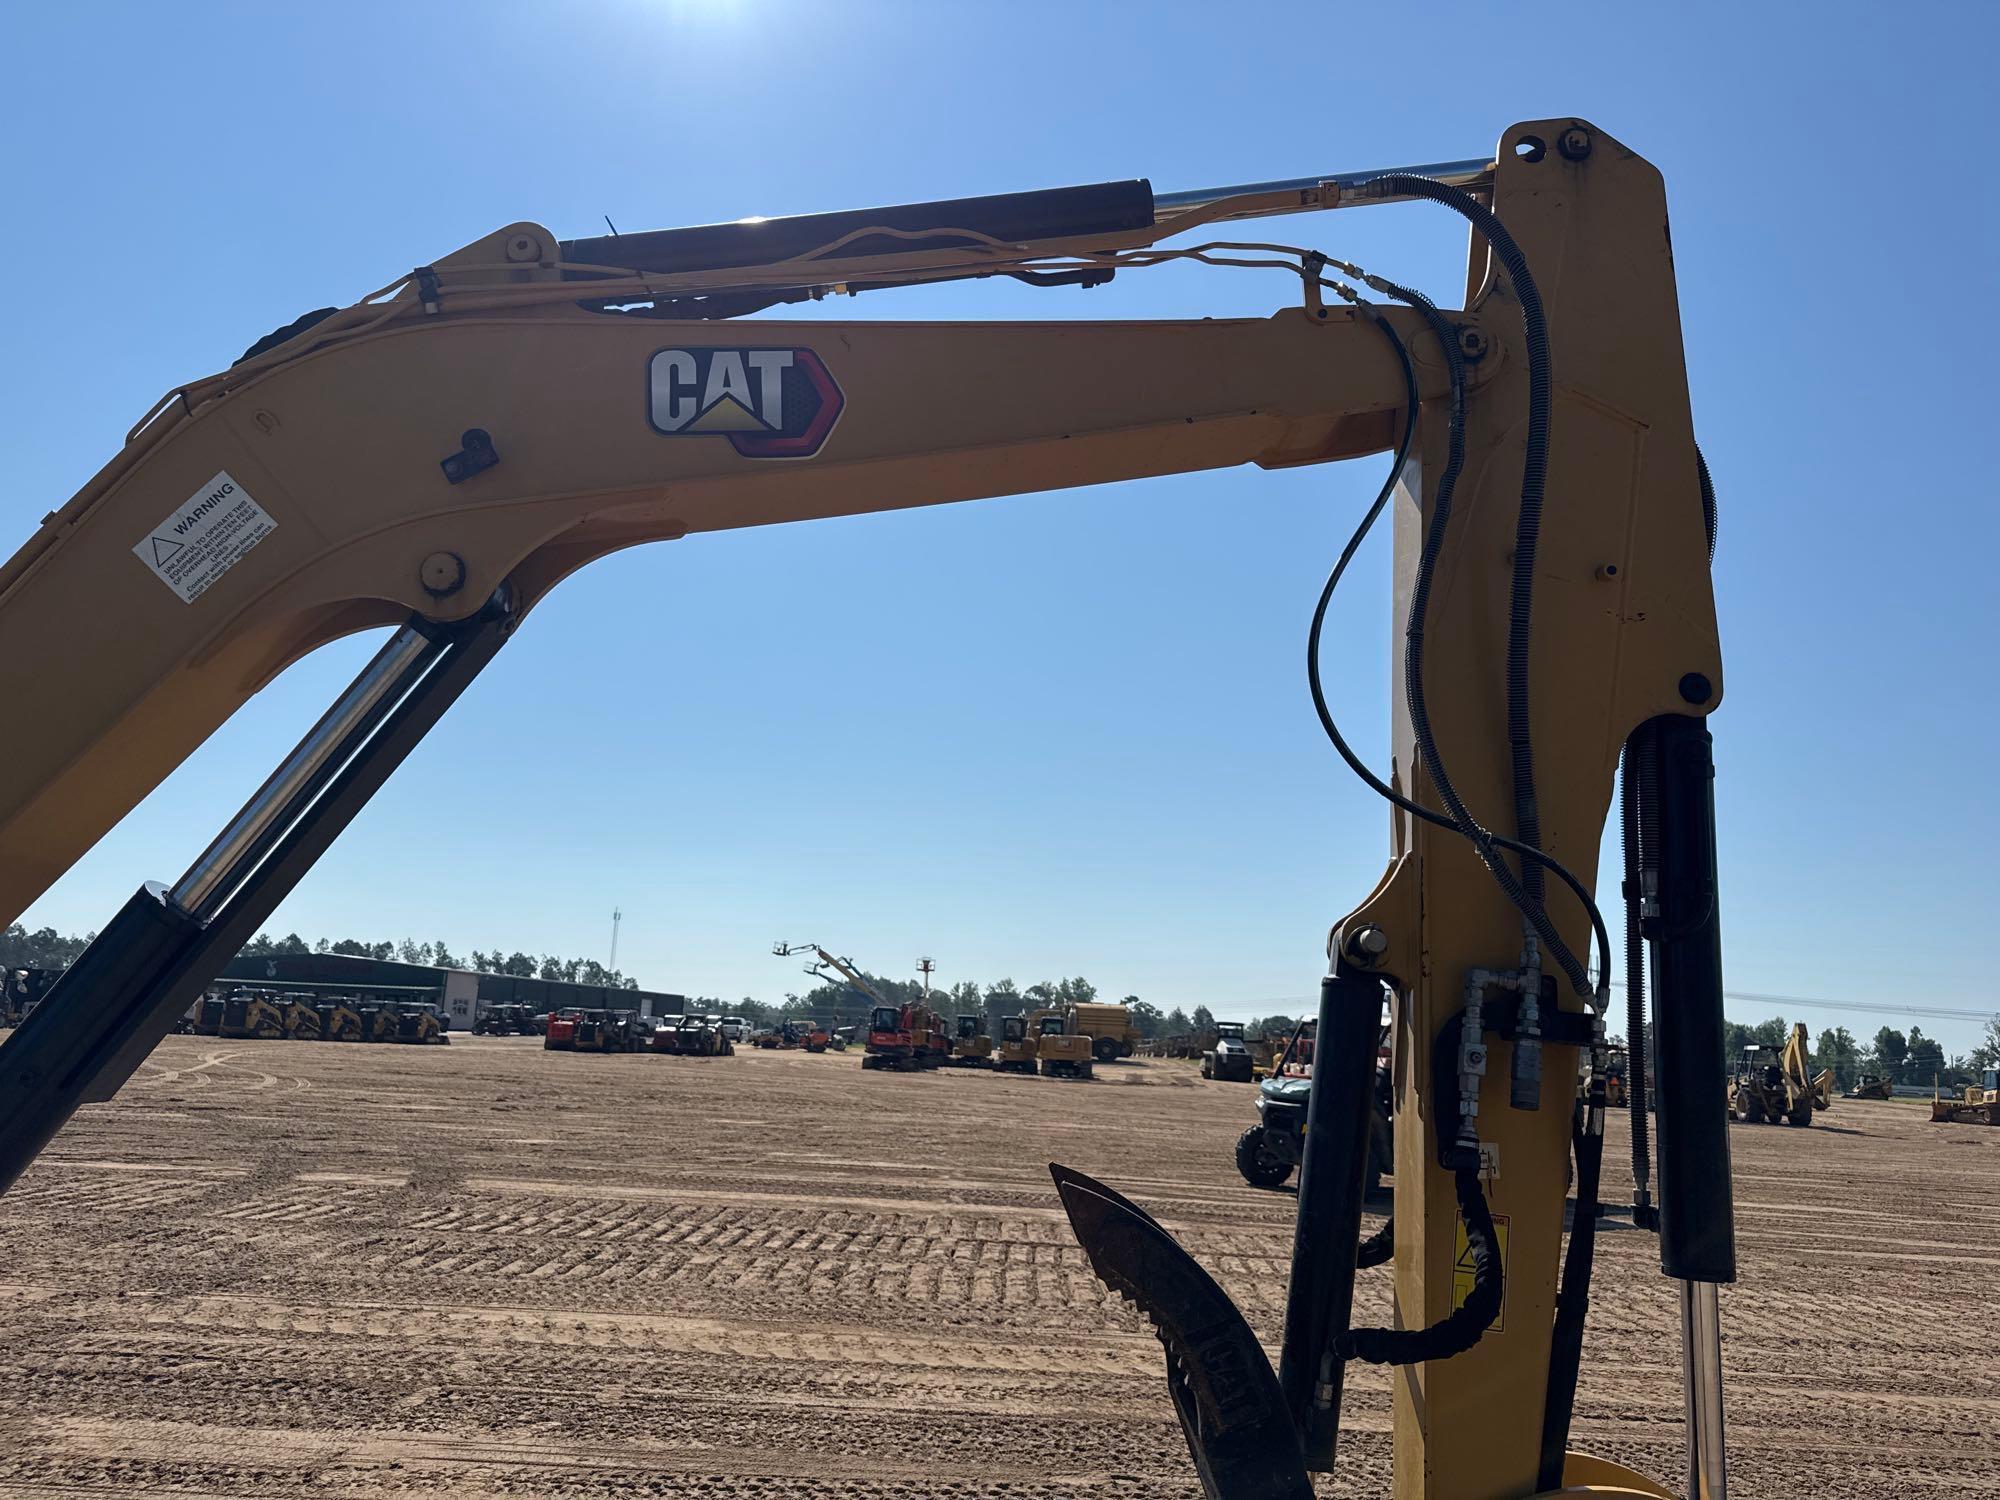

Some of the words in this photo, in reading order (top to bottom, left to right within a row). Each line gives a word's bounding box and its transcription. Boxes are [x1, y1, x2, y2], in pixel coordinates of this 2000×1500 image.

[651, 350, 794, 432] CAT
[163, 545, 197, 575] UNLAWFUL
[195, 536, 206, 546] TO
[204, 511, 234, 539] OPERATE
[232, 500, 248, 514] THIS
[168, 546, 204, 580] EQUIPMENT
[202, 529, 226, 549] WITHIN
[223, 518, 238, 531] TEN
[235, 504, 253, 520] FEET
[173, 483, 235, 535] WARNING
[173, 575, 183, 585] OF
[182, 545, 217, 577] OVERHEAD
[186, 571, 210, 592] Contact
[208, 559, 224, 573] with
[221, 544, 240, 565] power
[238, 532, 255, 546] lines
[253, 522, 265, 534] can
